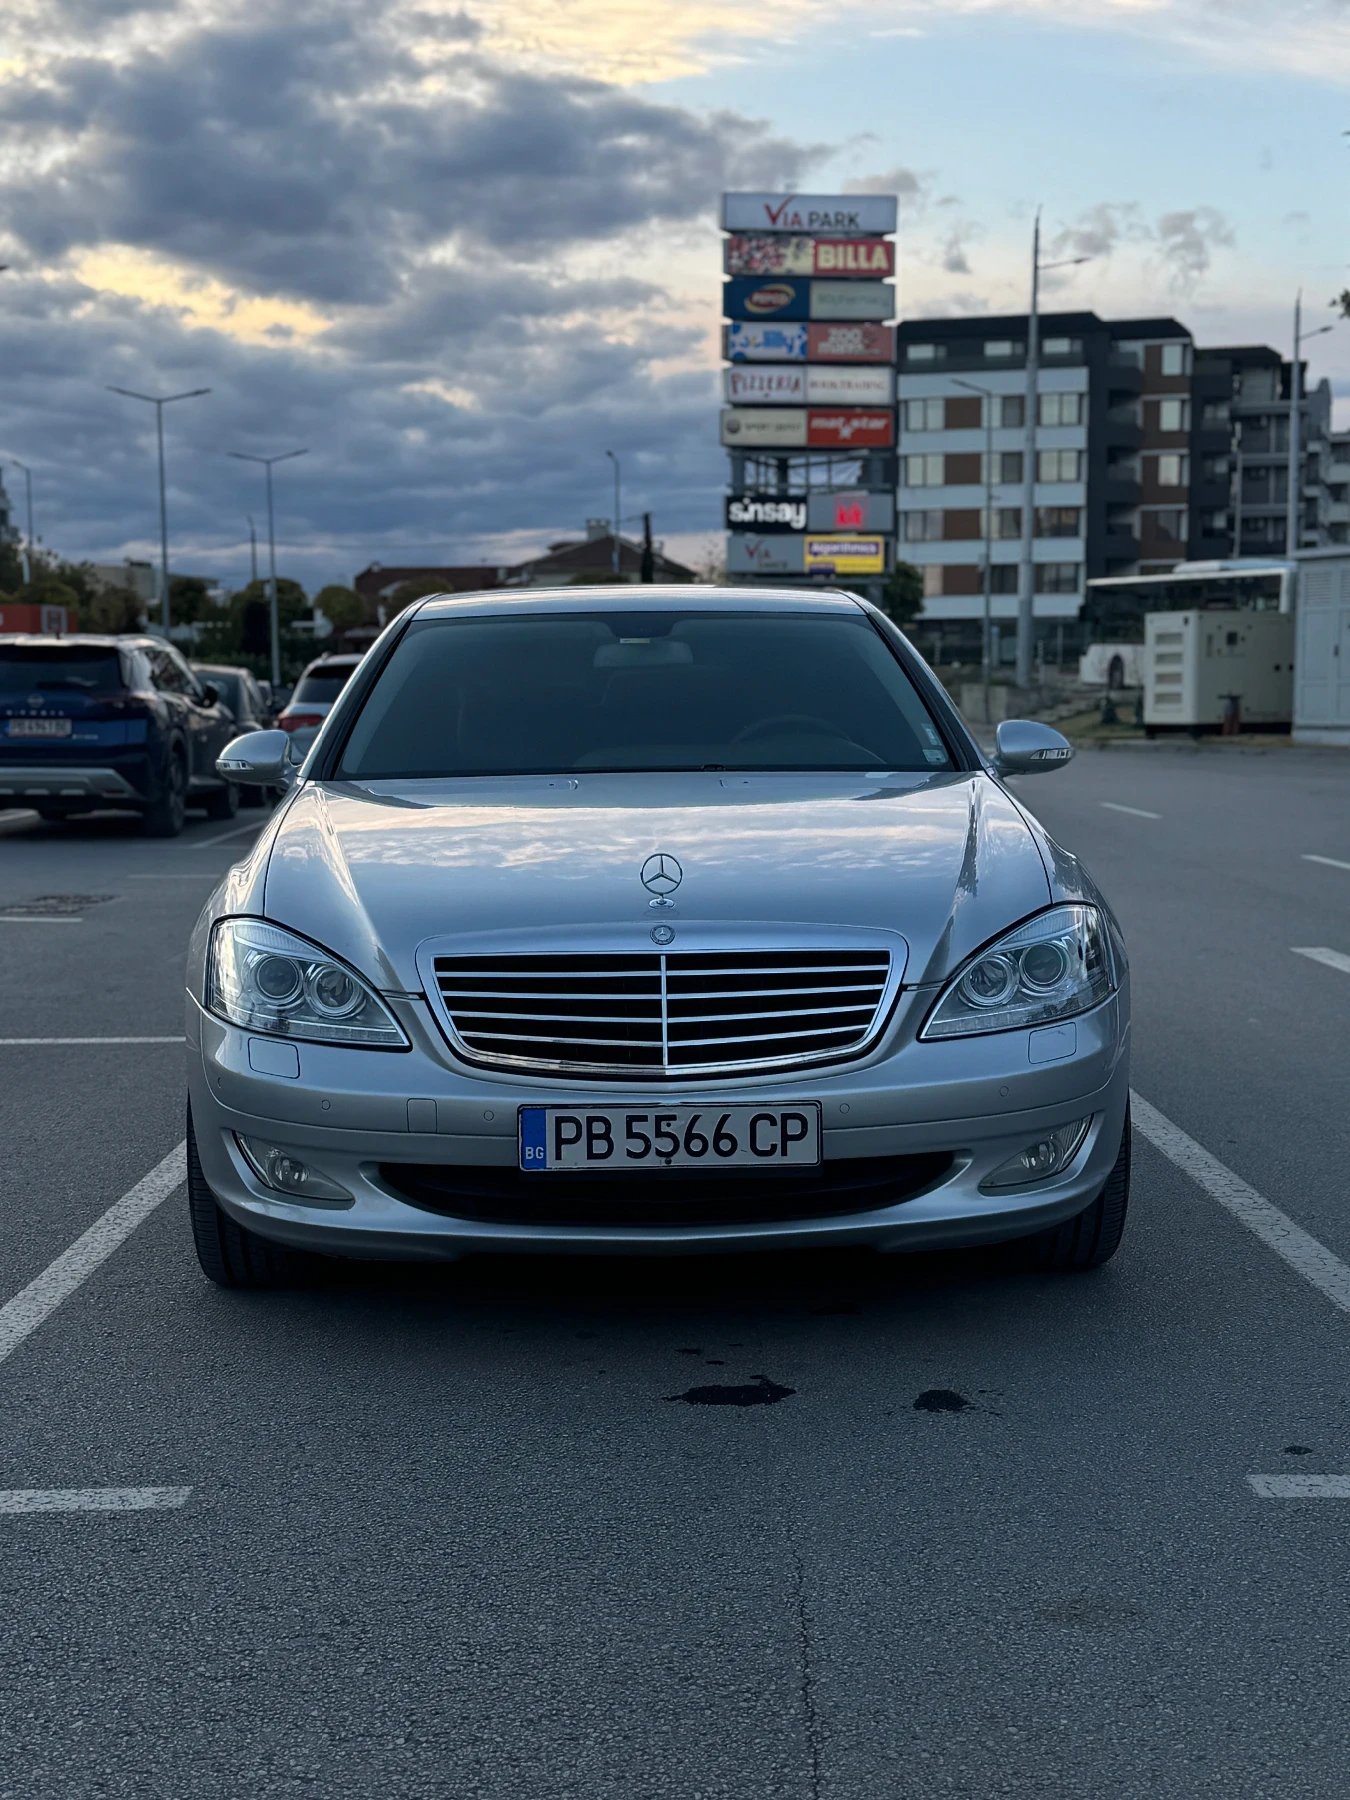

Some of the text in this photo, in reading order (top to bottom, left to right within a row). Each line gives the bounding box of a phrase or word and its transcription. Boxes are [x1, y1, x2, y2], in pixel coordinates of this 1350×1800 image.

[764, 195, 860, 229] VIA PARK
[816, 244, 890, 271] BILLA
[728, 497, 807, 530] sinsay
[554, 1112, 809, 1161] PB 5566 CP
[525, 1146, 545, 1161] BG
